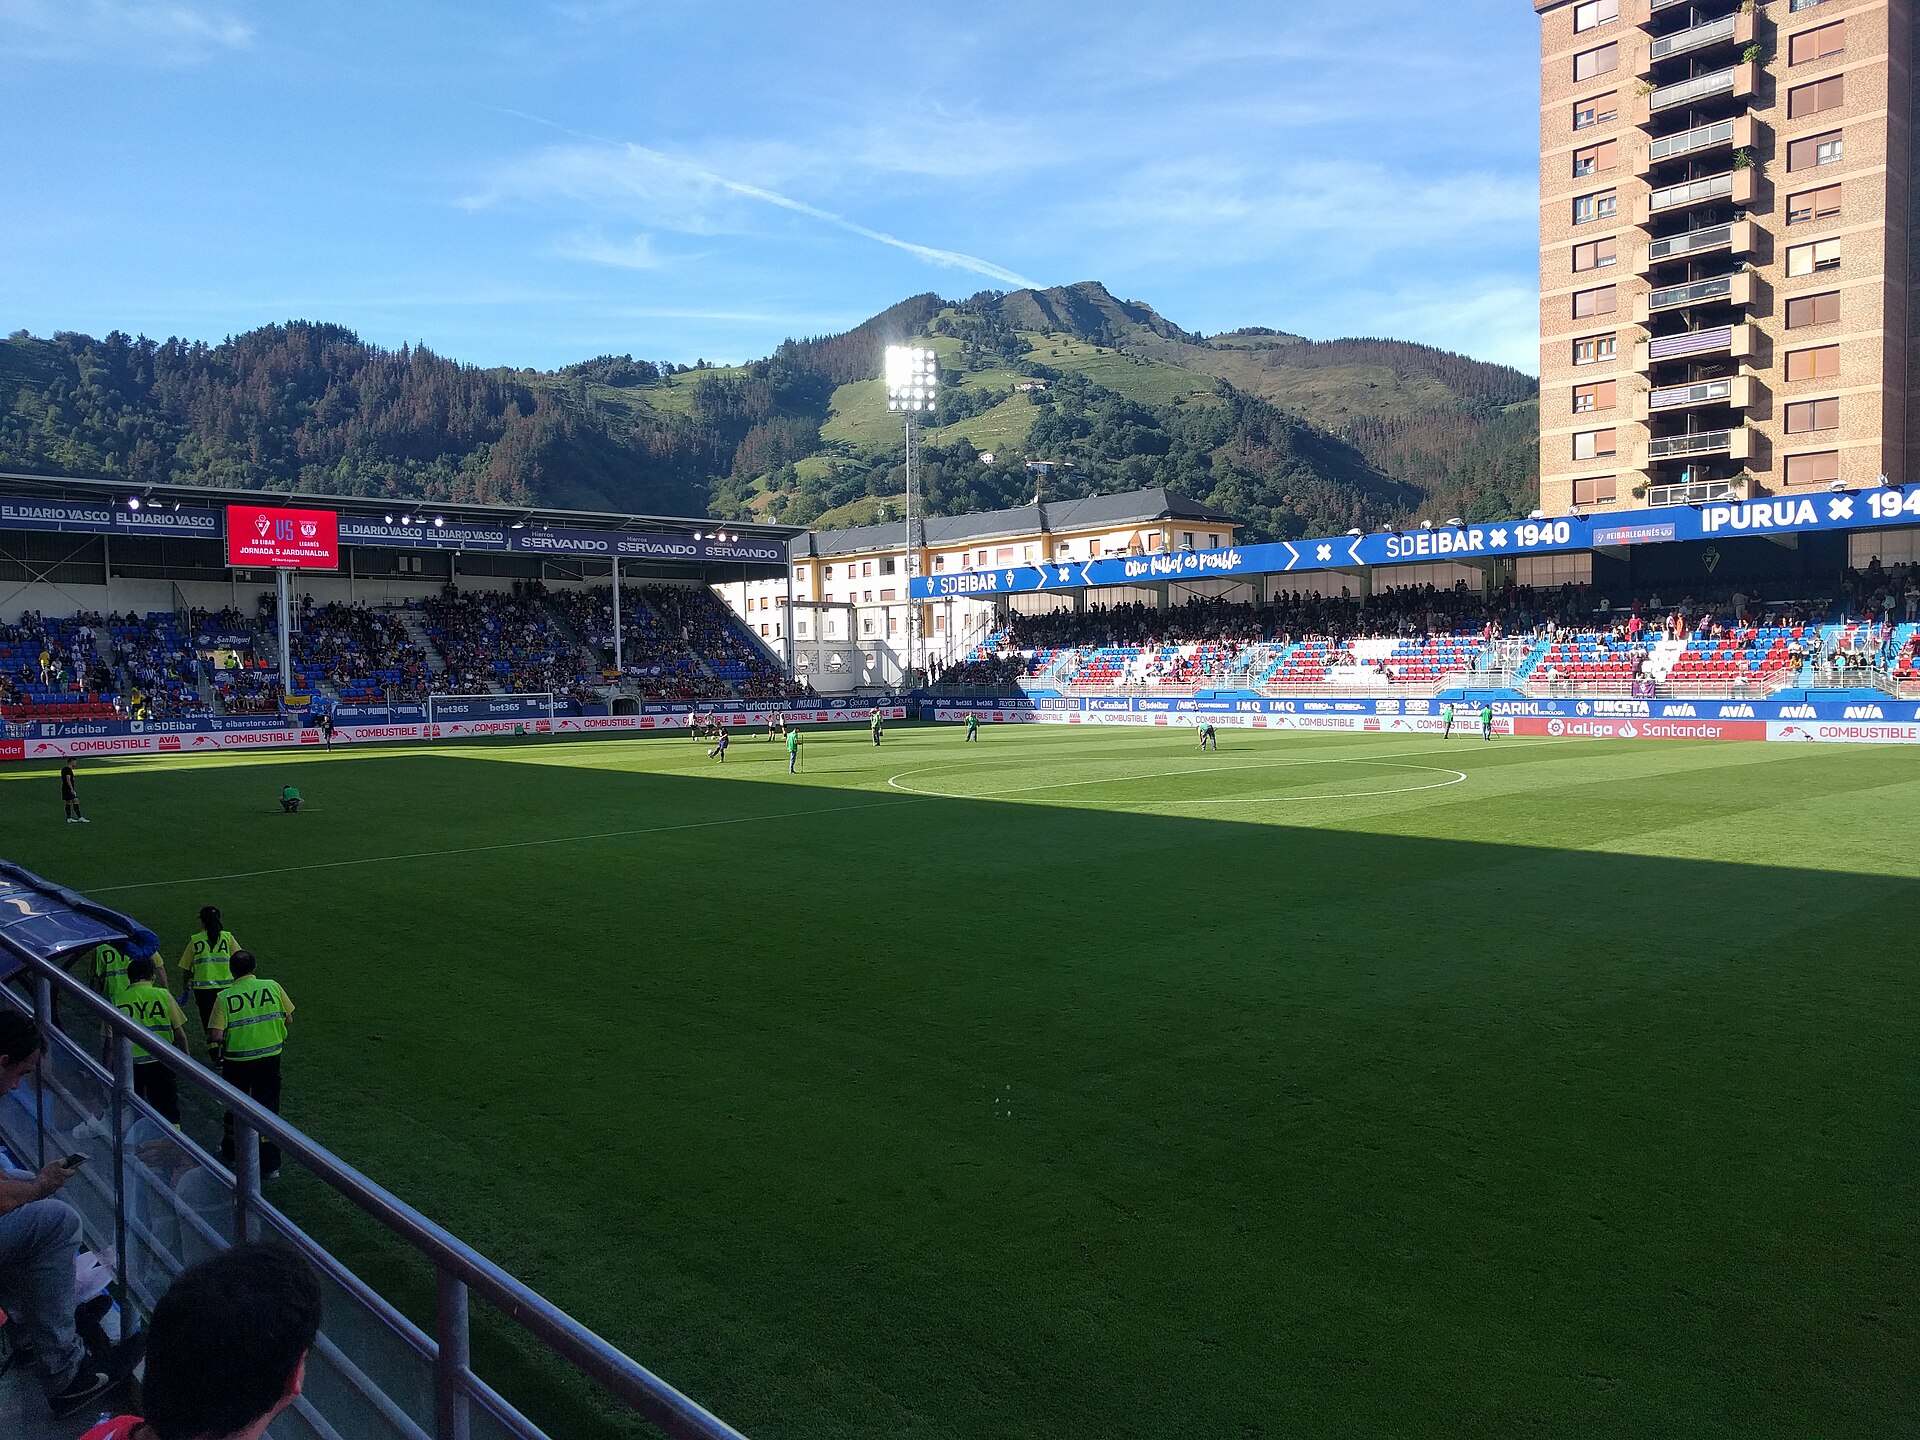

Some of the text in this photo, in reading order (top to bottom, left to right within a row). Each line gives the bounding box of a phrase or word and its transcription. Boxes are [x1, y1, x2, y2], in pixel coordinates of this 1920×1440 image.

[2, 506, 110, 521] EL DIARIO VASCO
[1702, 499, 1818, 533] IPURUA
[116, 512, 215, 527] EL DIARIO VASCO
[339, 524, 422, 537] EL DIARIO VASCO
[427, 529, 439, 538] EL
[473, 531, 504, 540] VASCO
[1514, 521, 1570, 547] 1940
[521, 536, 609, 551] SERVANDO
[617, 542, 697, 555] SERVANDO
[240, 547, 274, 555] JORNADA
[282, 548, 329, 557] JARDUNALDIA
[705, 547, 778, 559] SERVANDO
[1184, 554, 1198, 568] es
[437, 705, 469, 714] bet365
[489, 703, 520, 711] bet365
[745, 700, 792, 710] urkotronik
[1098, 700, 1129, 709] CaixaBank
[1236, 701, 1262, 712] IMQ
[1269, 701, 1296, 713] IMQ
[1491, 702, 1538, 715] SARIKI
[1593, 701, 1650, 712] UNCETA
[336, 708, 358, 716] PUMA
[367, 707, 388, 715] PUMA
[1025, 713, 1063, 721] COMBUSTIBLE
[1105, 714, 1148, 722] COMBUSTIBLE
[1195, 715, 1245, 724] COMBUSTIBLE
[1299, 717, 1355, 727] COMBUSTIBLE
[145, 721, 197, 731] @SDEibar
[225, 720, 285, 728] eibarstore.com
[584, 718, 636, 728] COMBUSTIBLE
[355, 726, 418, 738] COMBUSTIBLE
[1567, 721, 1722, 738] LaLiga Santander
[1819, 727, 1917, 739] COMBUSTIBLE
[224, 732, 294, 744] COMBUSTIBLE
[0, 745, 21, 754] nder
[70, 739, 151, 752] COMBUSTIBLE
[226, 987, 276, 1015] DYA
[115, 1000, 167, 1020] DYA
